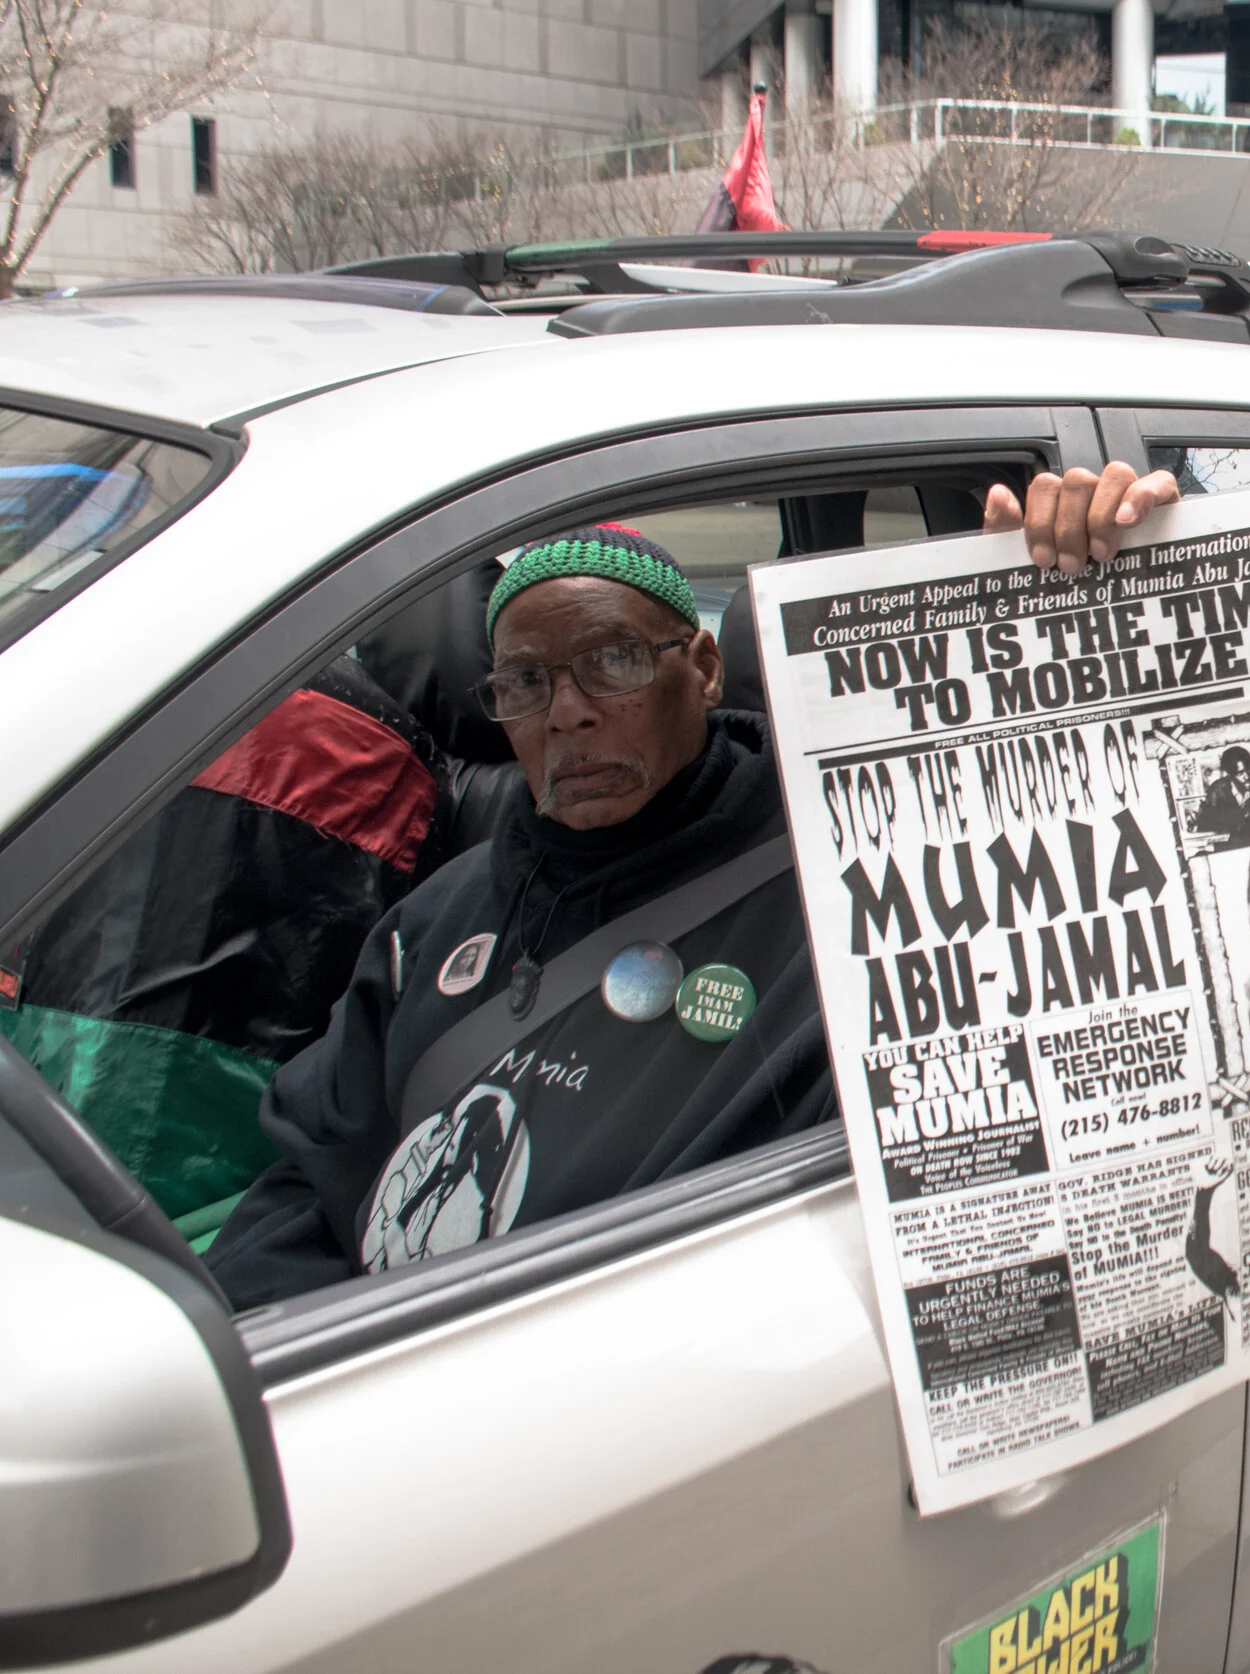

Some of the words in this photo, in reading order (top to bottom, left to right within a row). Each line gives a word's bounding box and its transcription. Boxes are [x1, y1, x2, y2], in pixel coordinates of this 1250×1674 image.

[813, 614, 915, 647] Concerned
[922, 601, 985, 630] Family
[993, 597, 1009, 618] &
[1016, 584, 1088, 614] Friends
[1095, 579, 1116, 600] of
[1120, 568, 1184, 596] Mumia
[1190, 560, 1228, 584] Abu
[827, 598, 856, 619] An
[858, 587, 917, 614] Urgent
[921, 576, 981, 603] Appeal
[984, 572, 1006, 592] to
[1009, 567, 1032, 588] the
[1093, 549, 1141, 574] from
[824, 633, 953, 698] NOW
[966, 620, 1023, 674] IS
[1035, 599, 1149, 662] THE
[894, 678, 972, 734] TO
[987, 630, 1248, 718] MOBILIZE
[934, 737, 965, 749] FREE
[967, 732, 990, 743] ALL
[992, 721, 1054, 739] POLITICAL
[1056, 707, 1130, 727] PRISONERS!!!
[822, 761, 896, 861] STOP
[907, 750, 969, 842] THE
[975, 726, 1095, 833] MURDER
[1102, 718, 1143, 809] OF
[841, 808, 1167, 955] MUMIA
[695, 978, 744, 1001] FREE
[866, 905, 1186, 1045] ABU-JAMAL
[681, 1005, 743, 1031] JAMIL!
[697, 994, 734, 1012] IMAM
[1087, 1007, 1112, 1024] Join
[1119, 1002, 1138, 1017] the
[863, 1046, 909, 1072] YOU
[914, 1036, 961, 1062] CAN
[966, 1023, 1024, 1051] HELP
[1037, 1006, 1191, 1058] EMERGENCY
[888, 1045, 1011, 1106] SAVE
[1052, 1032, 1187, 1080] RESPONSE
[1062, 1057, 1186, 1104] NETWORK
[875, 1077, 1038, 1148] MUMIA
[1059, 1111, 1109, 1142] (215)
[1116, 1091, 1202, 1128] 476-8812
[1069, 1147, 1101, 1163] Leave
[1106, 1138, 1136, 1155] name
[1156, 1123, 1199, 1143] number!
[1092, 1165, 1132, 1182] RIDGE
[1136, 1157, 1161, 1172] HAS
[1165, 1145, 1212, 1165] SIGNED
[893, 1208, 931, 1223] MUMIA
[934, 1205, 945, 1215] IS
[949, 1203, 956, 1212] A
[960, 1190, 1018, 1209] SIGNATURE
[1022, 1183, 1050, 1196] AWAY
[895, 1222, 926, 1237] FROM
[931, 1219, 939, 1229] A
[943, 1209, 987, 1226] LETHAL
[1065, 1216, 1078, 1226] We
[1083, 1206, 1115, 1222] Believe
[1119, 1196, 1153, 1212] MUMIA
[1156, 1193, 1165, 1203] IS
[1168, 1185, 1194, 1200] NEXT!
[1066, 1226, 1083, 1239] Say
[1087, 1222, 1100, 1233] NO
[1104, 1218, 1113, 1229] to
[1117, 1209, 1145, 1225] LEGAL
[1149, 1197, 1190, 1216] MURDER!
[1071, 1245, 1102, 1266] Stop
[1107, 1238, 1129, 1255] the
[1135, 1224, 1184, 1247] Murder
[1073, 1267, 1087, 1282] of
[1093, 1246, 1159, 1277] MUMIA!!!
[918, 1284, 998, 1314] URGENTLY
[1002, 1269, 1060, 1294] NEEDED
[944, 1272, 997, 1295] FUNDS
[999, 1265, 1028, 1282] ARE
[928, 1385, 958, 1402] KEEP
[964, 1377, 985, 1392] THE
[990, 1359, 1049, 1385] PRESSURE
[1053, 1351, 1077, 1367] ON!!
[929, 1402, 952, 1415] CALL
[956, 1396, 970, 1407] OR
[973, 1387, 1003, 1403] WRITE
[1007, 1380, 1024, 1393] THE
[1028, 1364, 1081, 1387] GOVERNOR!
[989, 1554, 1122, 1674] BLACK
